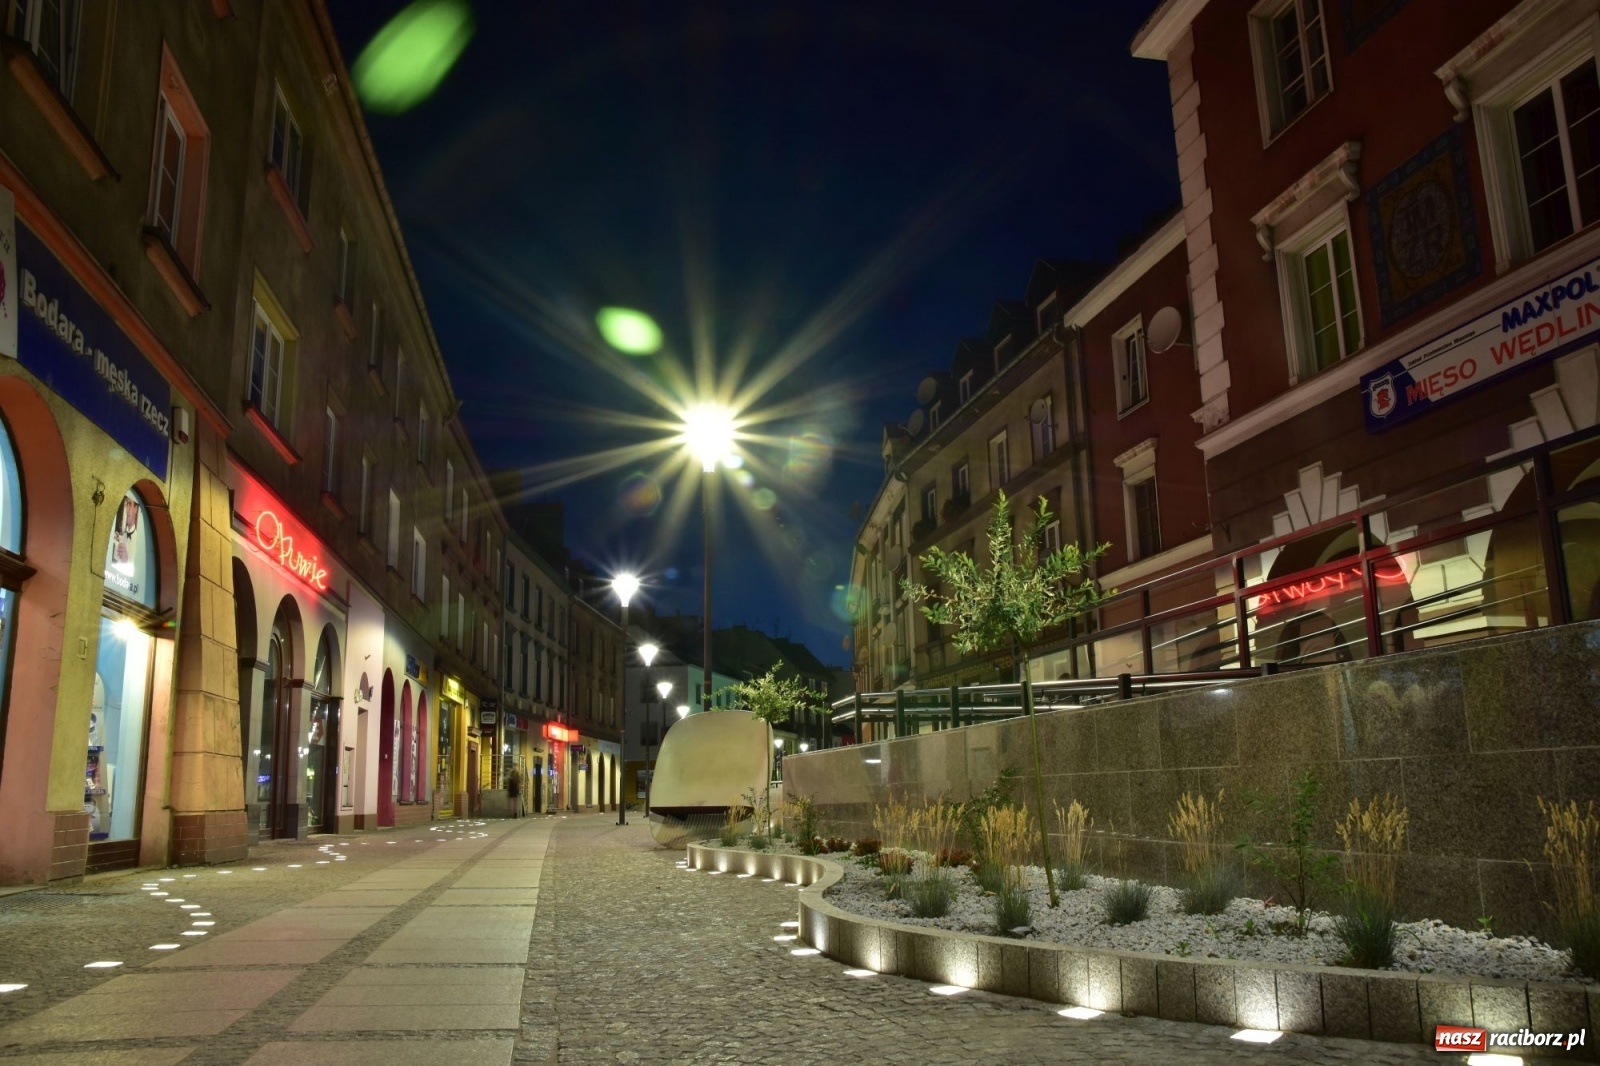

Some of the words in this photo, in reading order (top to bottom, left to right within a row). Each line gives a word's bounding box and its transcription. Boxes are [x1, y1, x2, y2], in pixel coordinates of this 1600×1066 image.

[1502, 271, 1600, 333] MAXPOL
[20, 267, 84, 355] Bodara
[94, 348, 139, 407] męska
[141, 393, 169, 437] rzecz
[1405, 358, 1477, 406] MIĘSO
[255, 510, 327, 589] Obuwie
